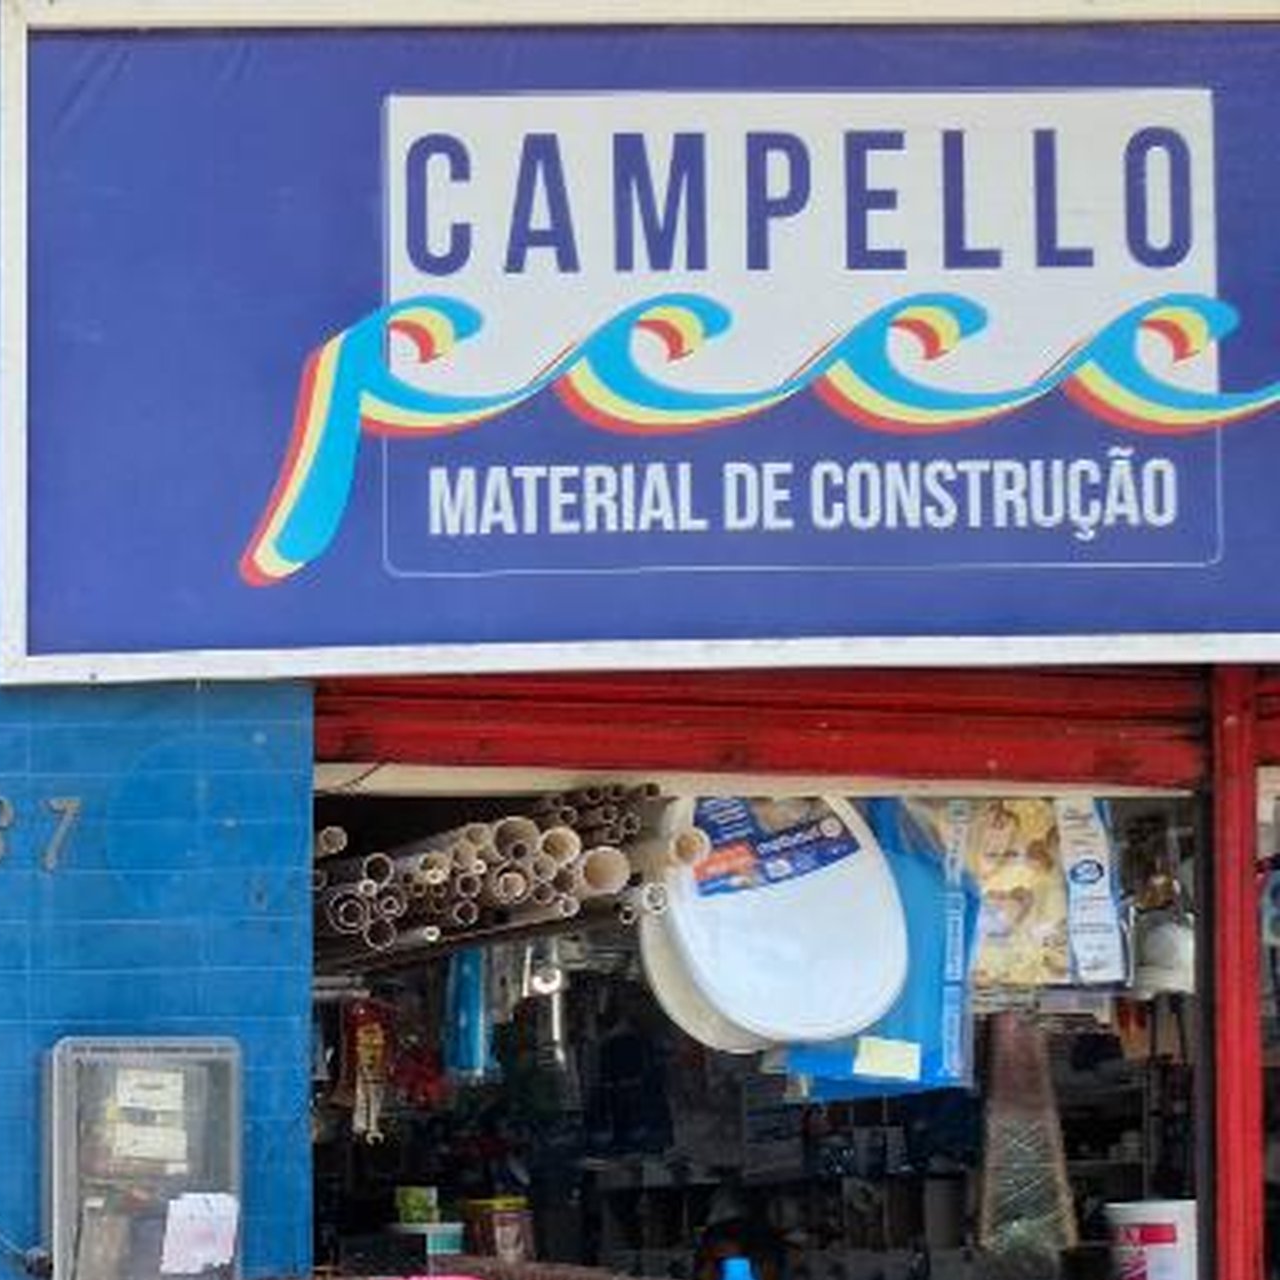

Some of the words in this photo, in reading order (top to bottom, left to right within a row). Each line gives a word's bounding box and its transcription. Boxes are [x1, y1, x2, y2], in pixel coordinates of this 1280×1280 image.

[404, 126, 1193, 276] CAMPELLO
[427, 462, 708, 535] MATERIAL
[723, 461, 795, 531] DE
[810, 447, 1178, 541] CONSTRUÇÃO
